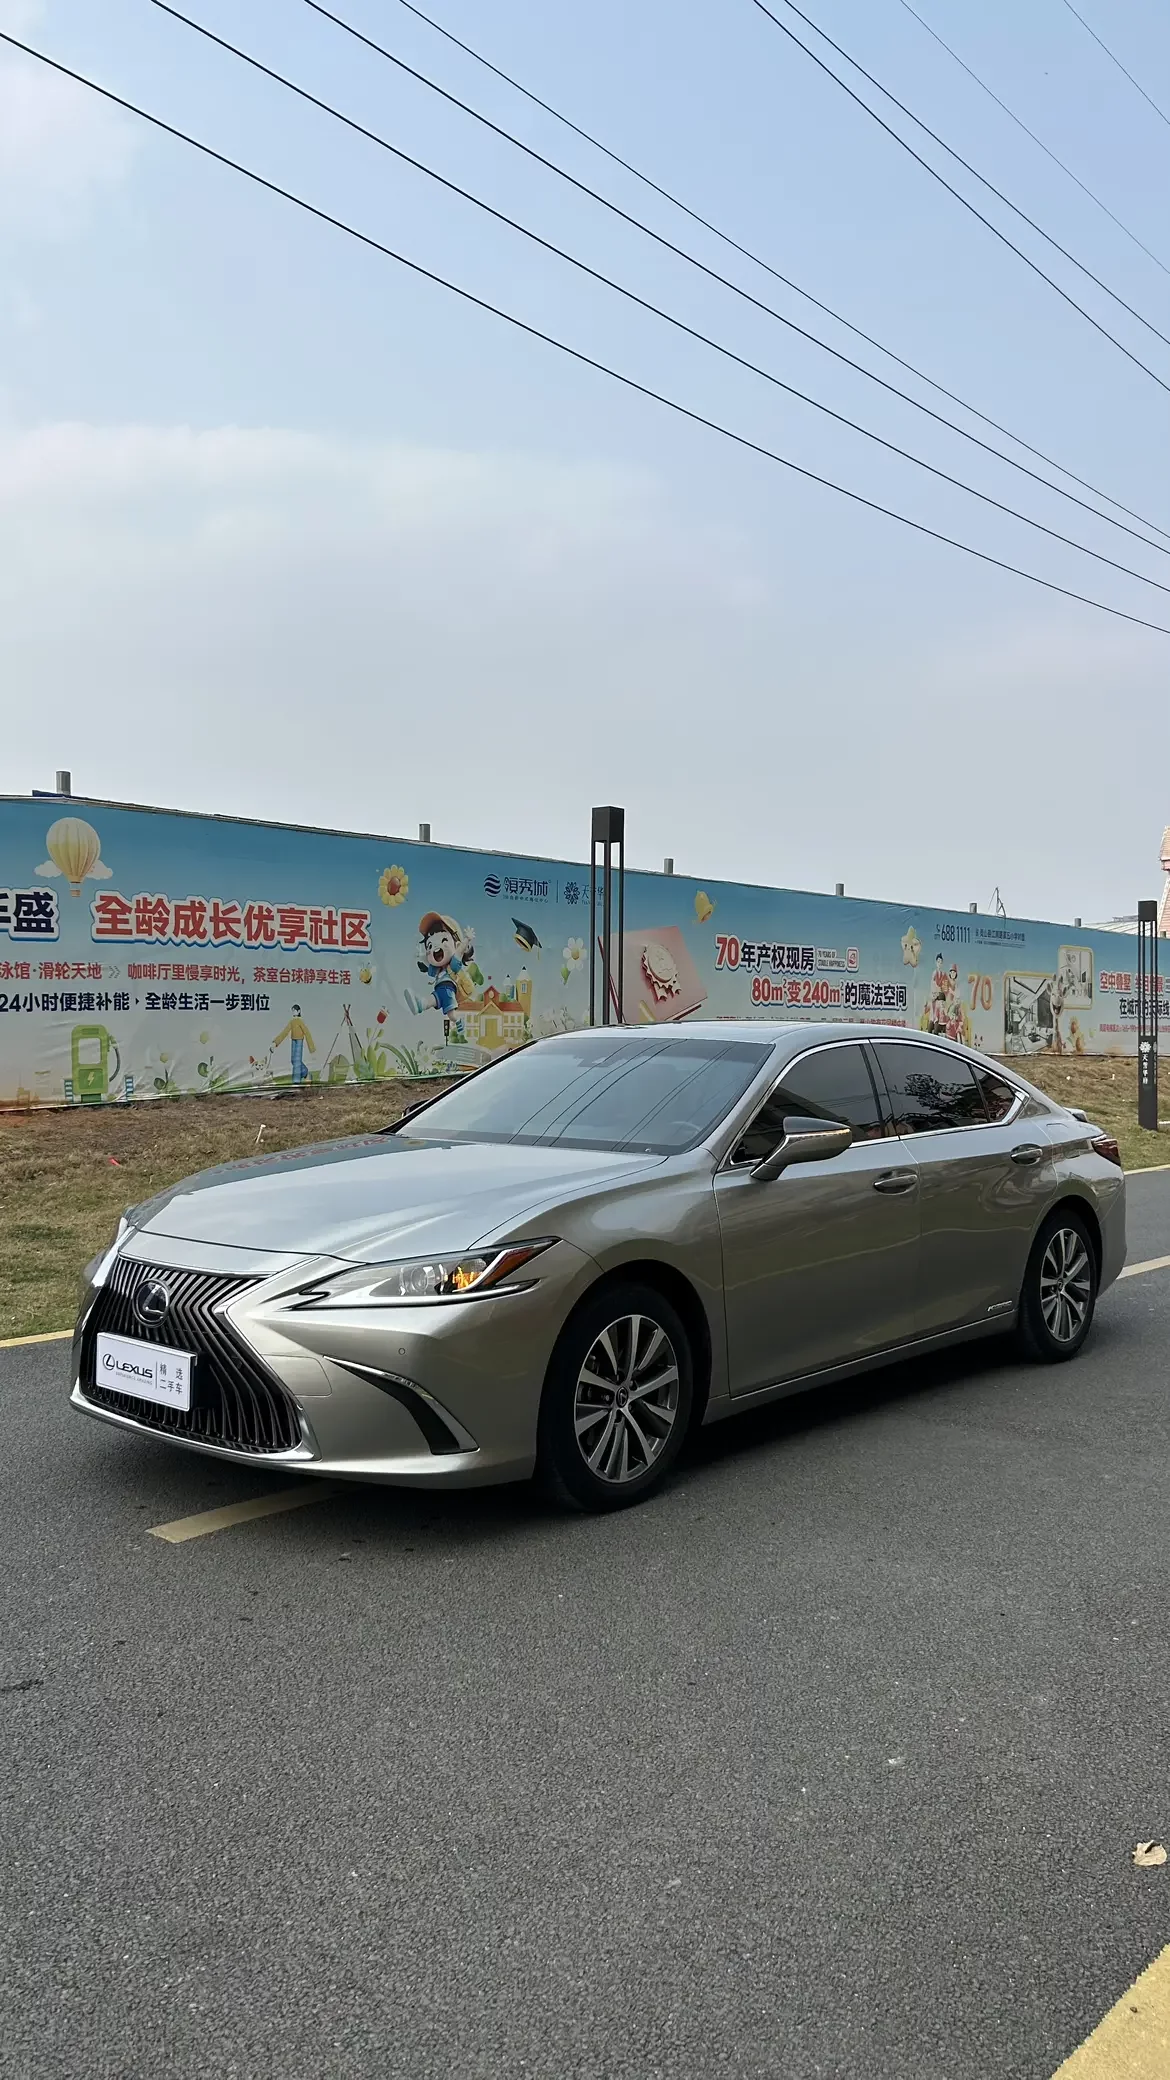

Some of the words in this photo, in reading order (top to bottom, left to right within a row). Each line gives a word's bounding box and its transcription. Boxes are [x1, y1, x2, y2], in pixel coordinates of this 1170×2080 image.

[0, 892, 54, 933] 盛
[95, 895, 369, 947] 全龄成长优享社区
[717, 937, 813, 970] 70年产权现房
[0, 992, 130, 1012] 24小时便捷补能
[145, 993, 270, 1011] 全龄生活一步到位
[116, 1361, 153, 1378] LEXUS
[160, 1379, 183, 1394] 二手车
